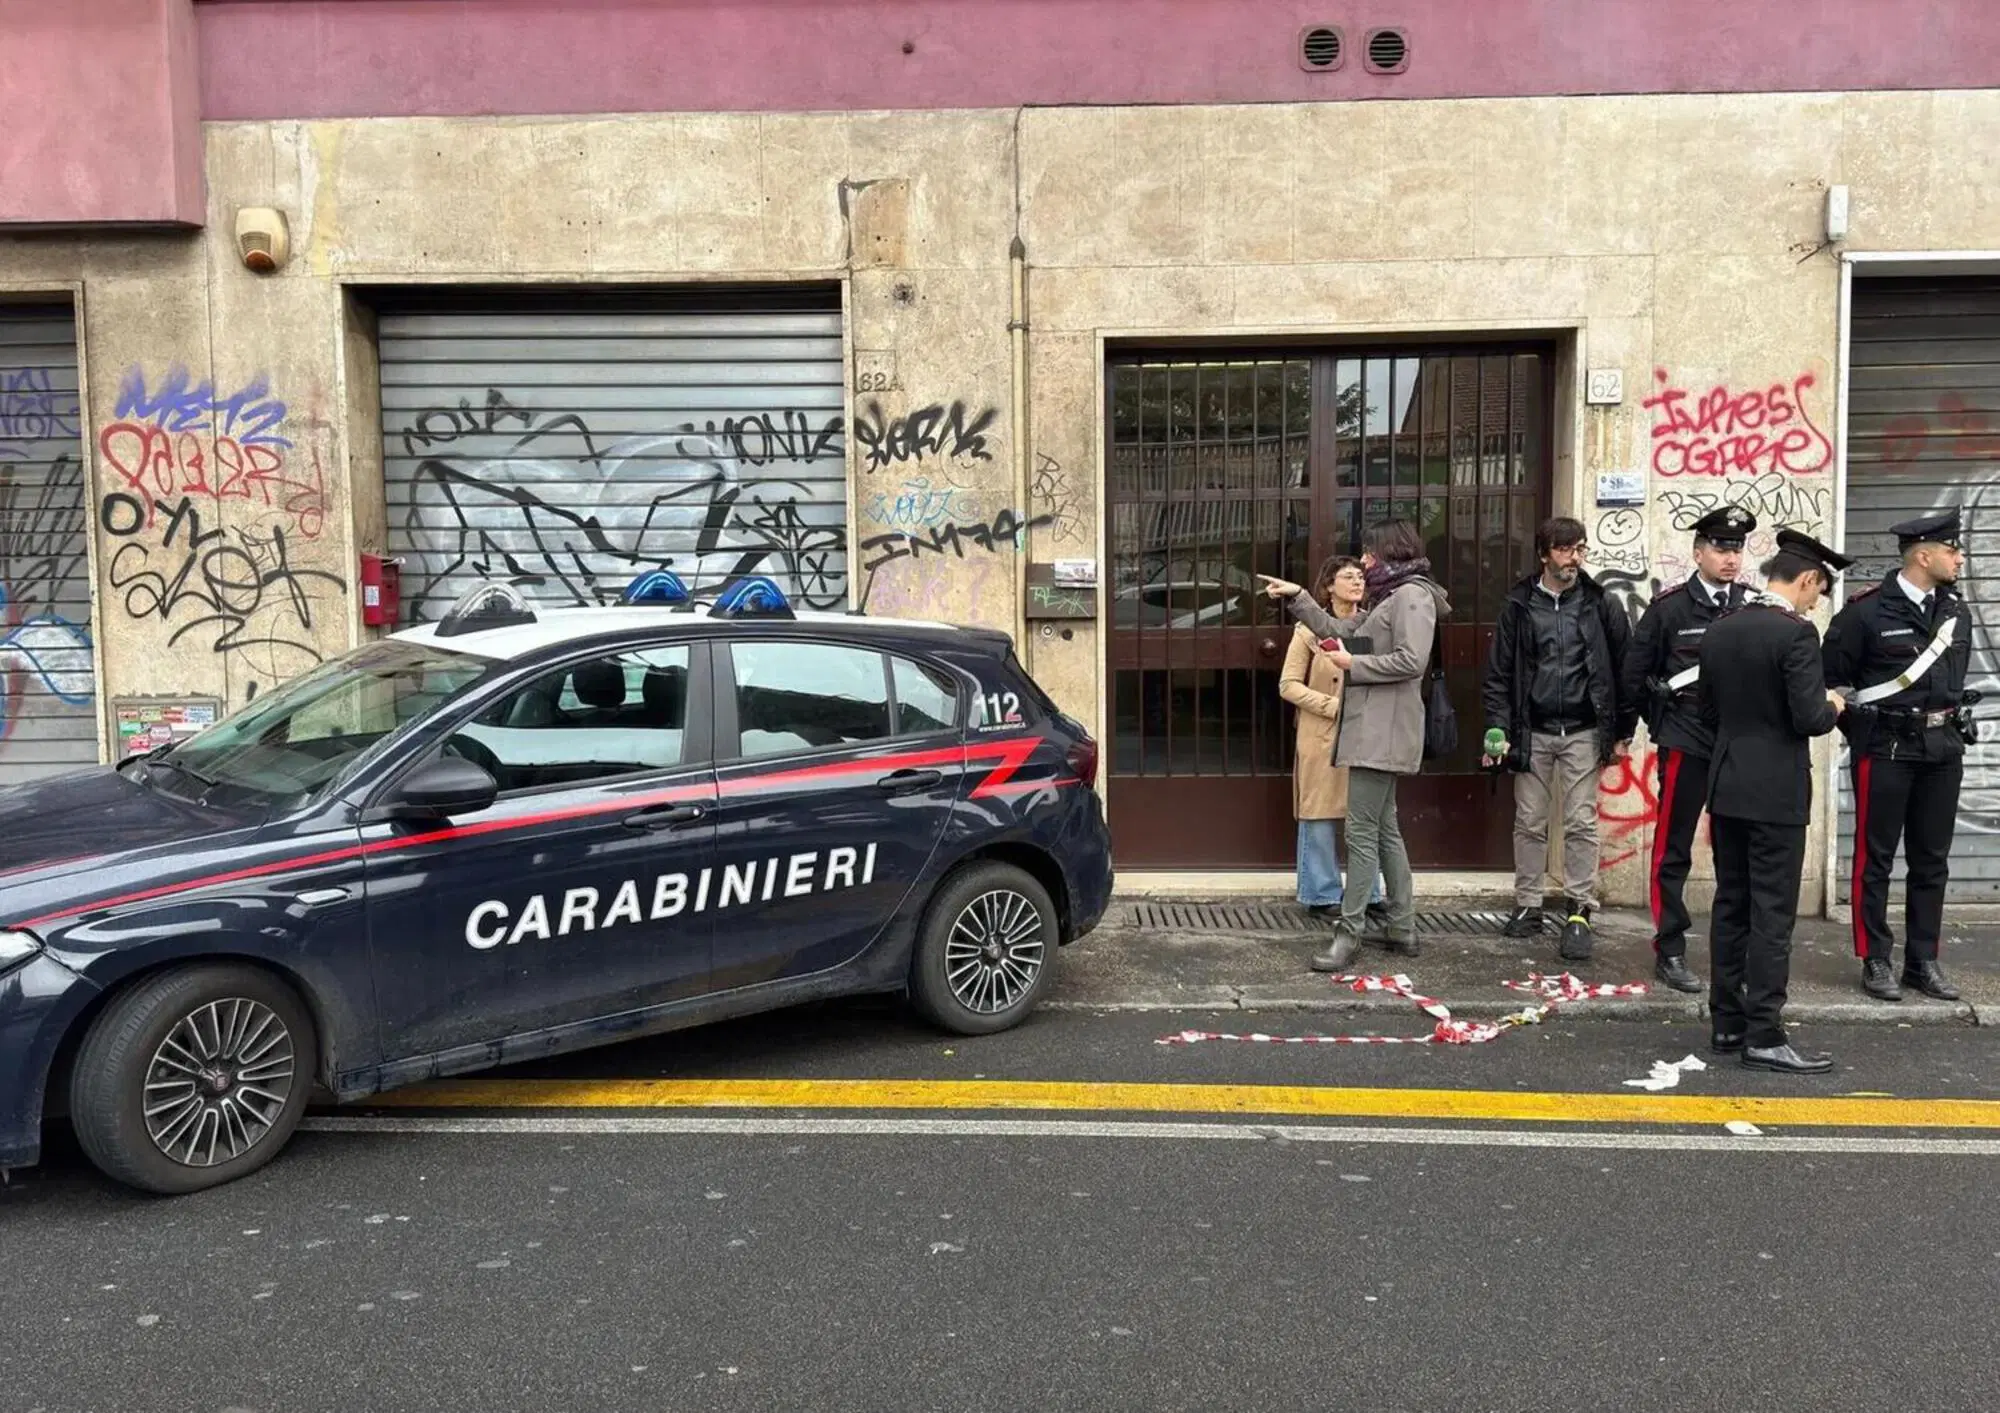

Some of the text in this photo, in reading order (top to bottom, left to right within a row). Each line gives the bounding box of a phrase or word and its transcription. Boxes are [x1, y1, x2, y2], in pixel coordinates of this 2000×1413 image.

[860, 371, 905, 392] 62A
[1591, 374, 1620, 399] 62
[973, 691, 1023, 725] 112
[465, 842, 878, 950] CARABINIERI
